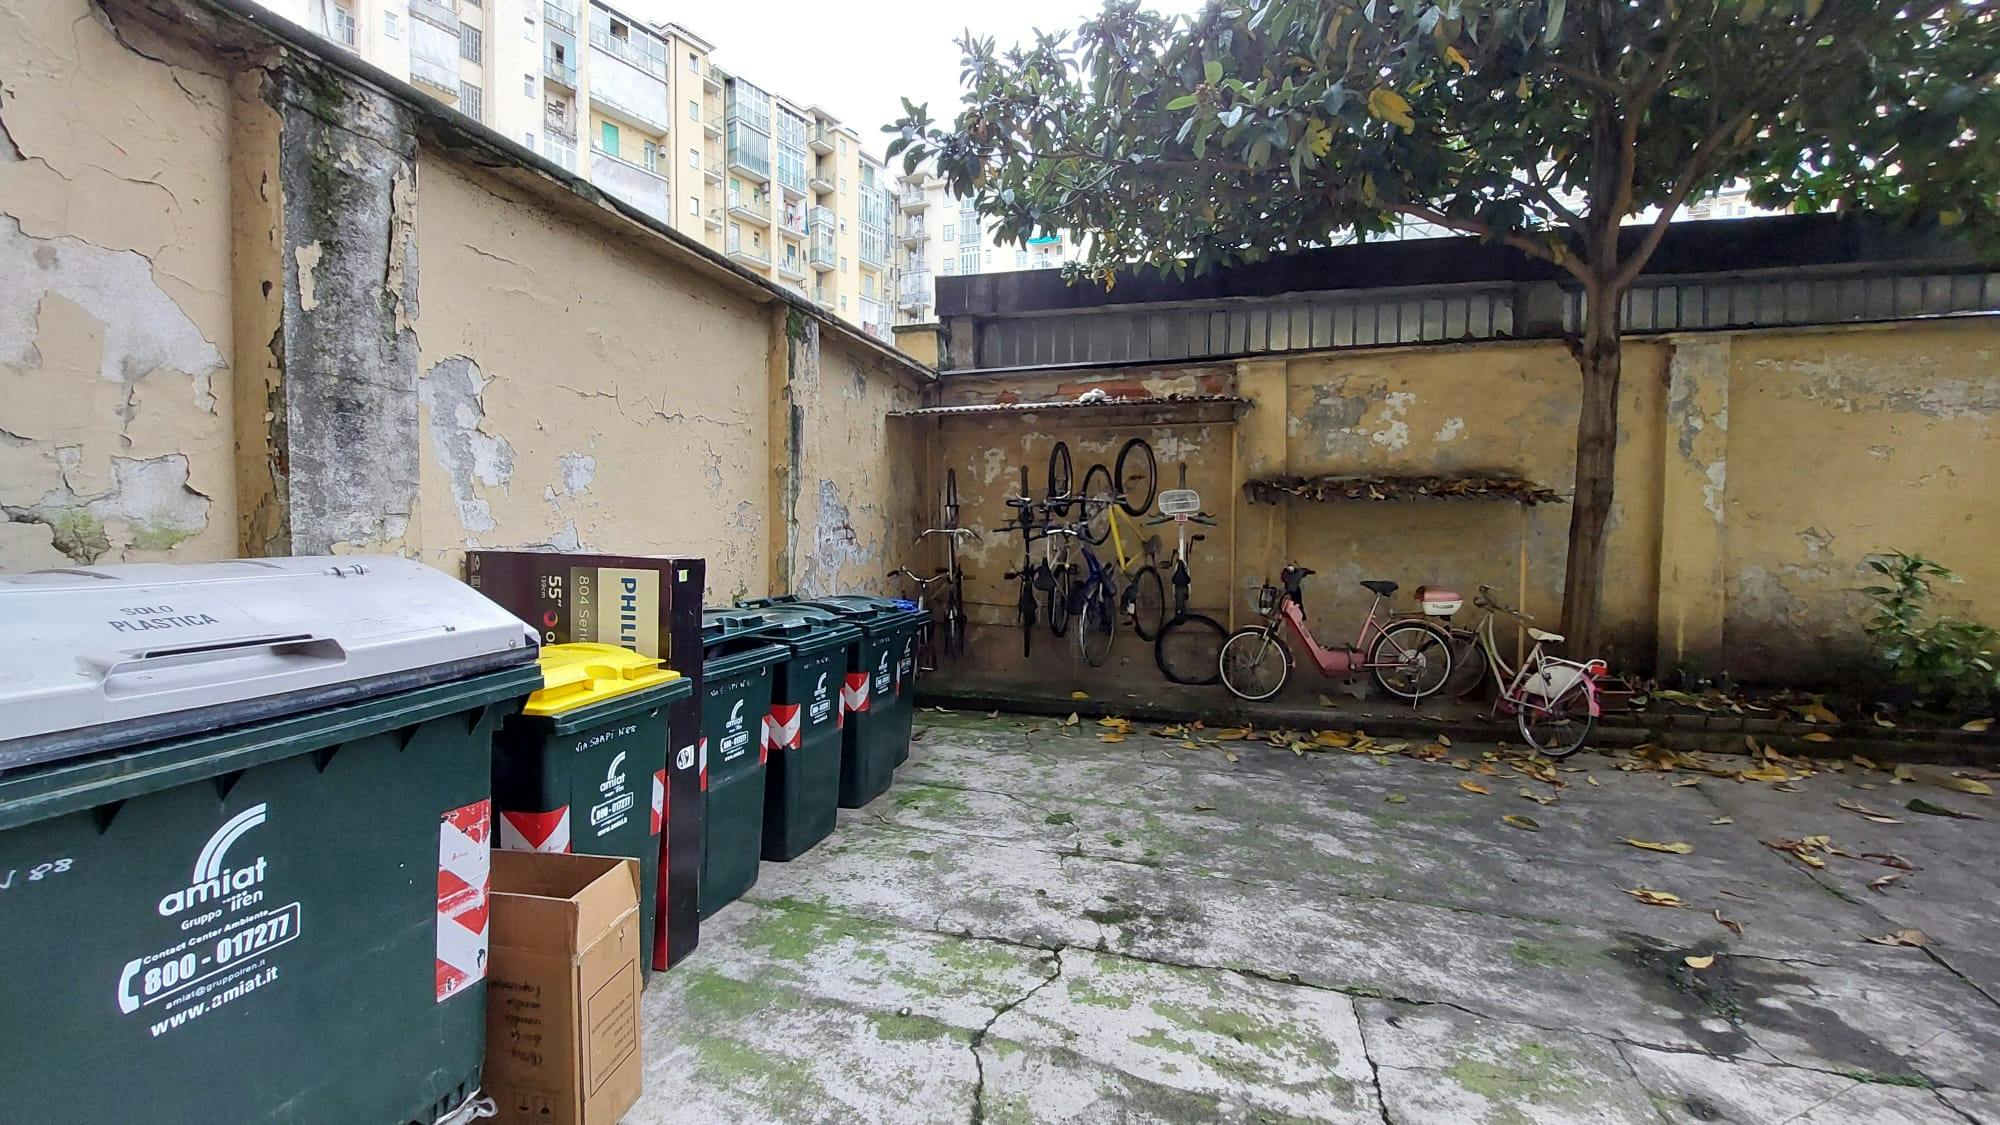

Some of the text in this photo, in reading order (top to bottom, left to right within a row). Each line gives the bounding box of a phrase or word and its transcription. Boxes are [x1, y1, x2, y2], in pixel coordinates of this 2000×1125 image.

[120, 605, 174, 616] SOLO
[578, 576, 590, 605] 804
[108, 613, 219, 632] PLASTICA
[600, 772, 625, 792] amiat
[159, 856, 267, 916] amiat
[143, 909, 269, 965] Contact Center Ambiente
[181, 909, 222, 930] Gruppo
[144, 952, 196, 995] 800
[216, 913, 290, 964] 017277
[151, 965, 279, 1037] www.amiat.it
[166, 959, 266, 1010] amiat@gruppoiren.it
